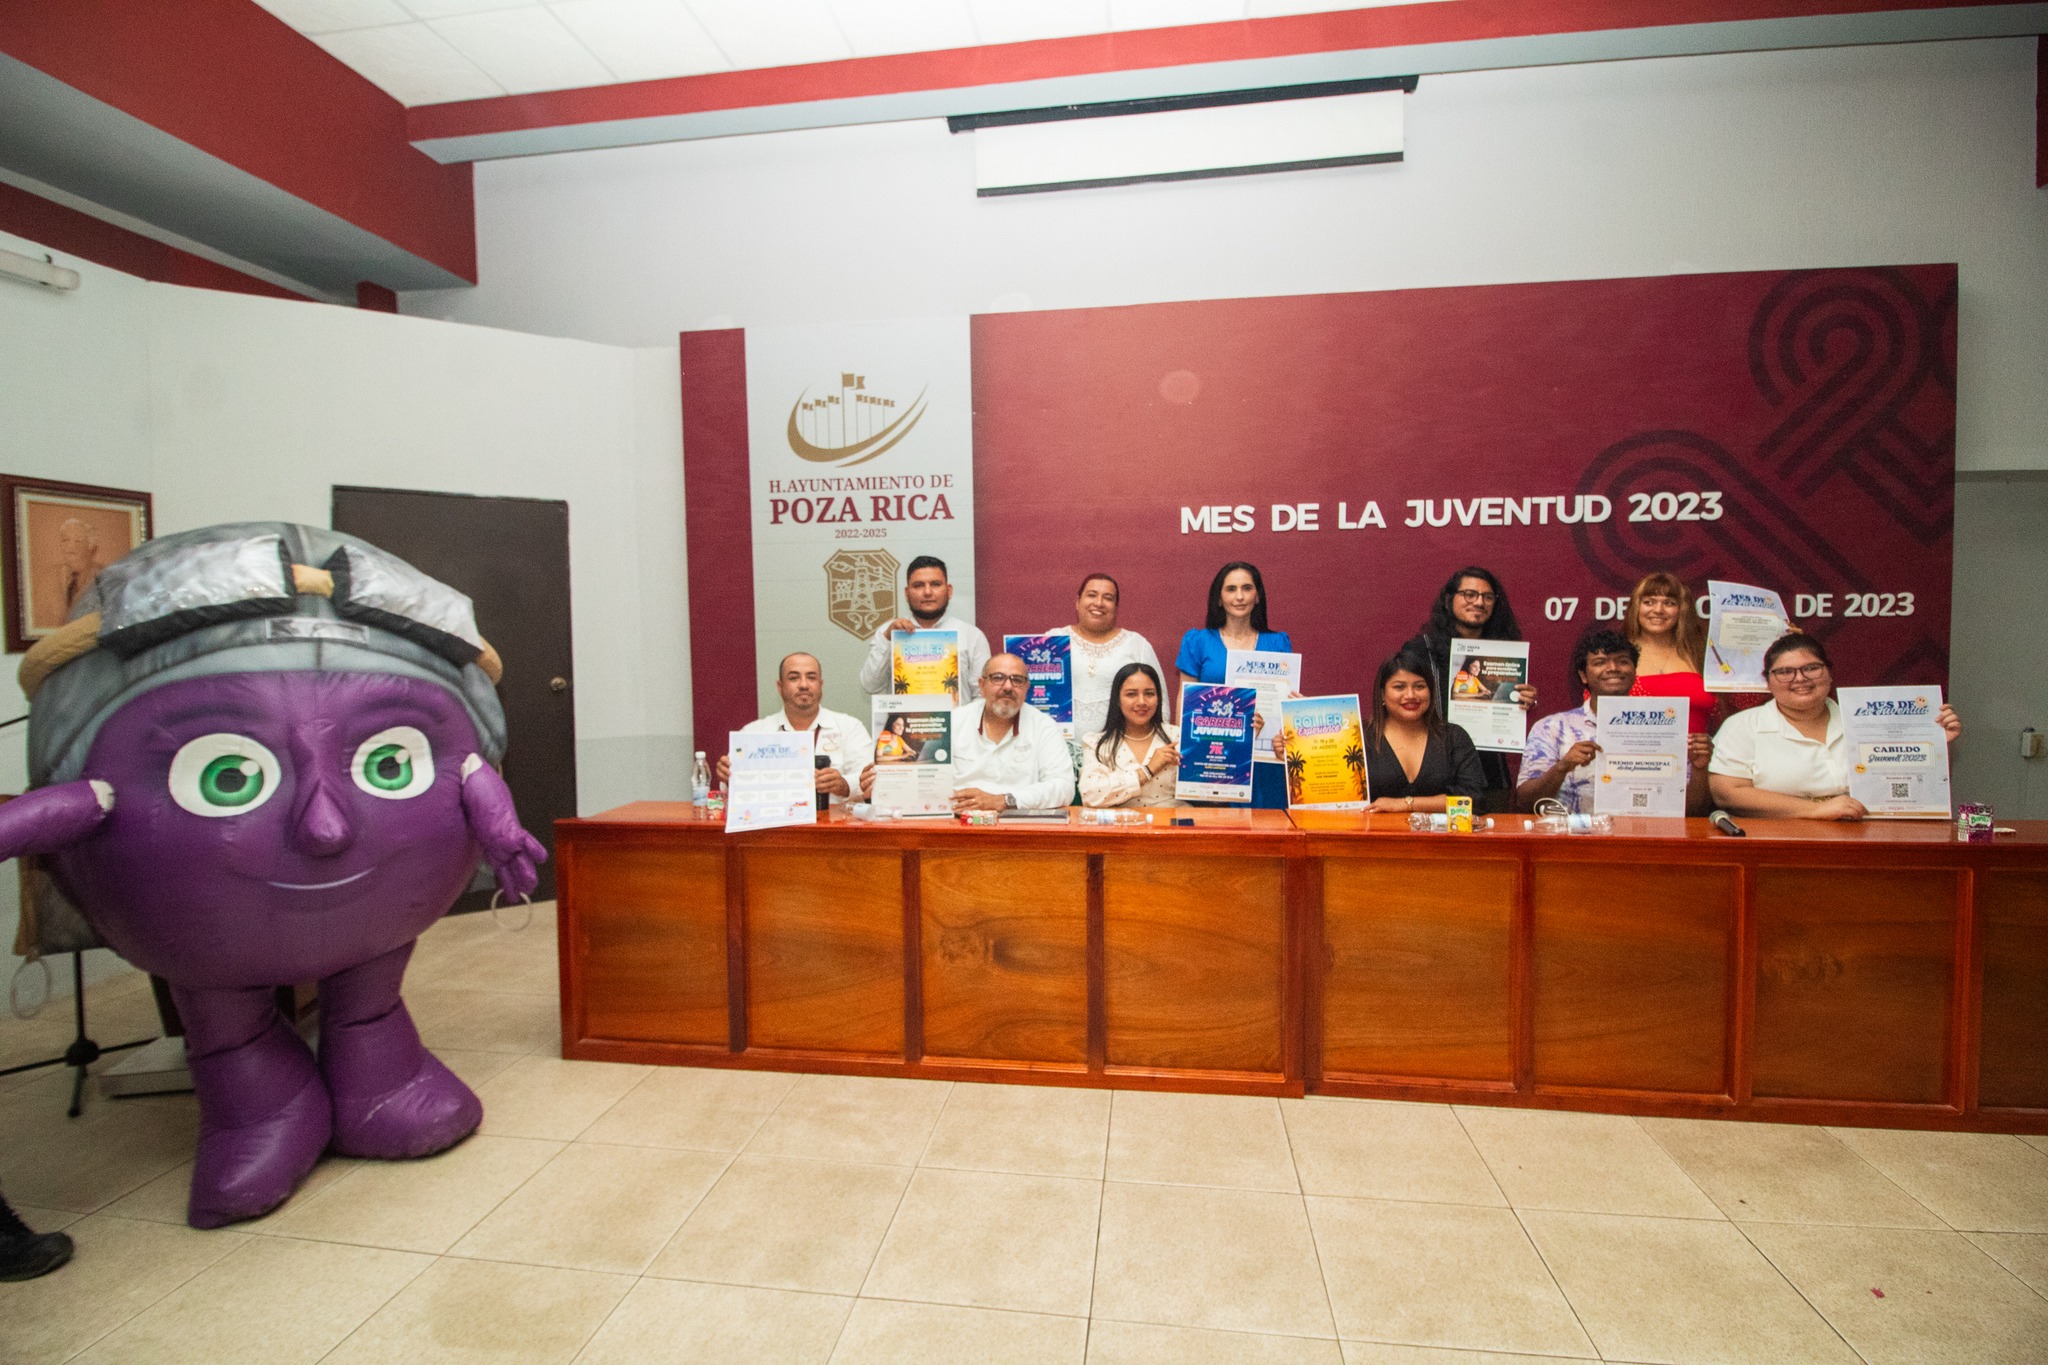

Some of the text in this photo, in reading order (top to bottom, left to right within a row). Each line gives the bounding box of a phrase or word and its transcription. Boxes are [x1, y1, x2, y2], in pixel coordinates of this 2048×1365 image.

[769, 474, 954, 493] H.AYUNTAMIENTO DE
[770, 494, 954, 525] POZA RICA
[1181, 491, 1724, 534] MES DE LA JUVENTUD 2023
[835, 528, 887, 539] 2022-2025
[1545, 597, 1579, 621] 07
[1795, 592, 1915, 617] DE 2023
[1028, 672, 1062, 681] VENTUD
[1194, 716, 1243, 728] CARRERA
[1294, 714, 1342, 729] ROLLER
[1342, 719, 1350, 729] 2
[1193, 726, 1243, 737] JUVENTUD
